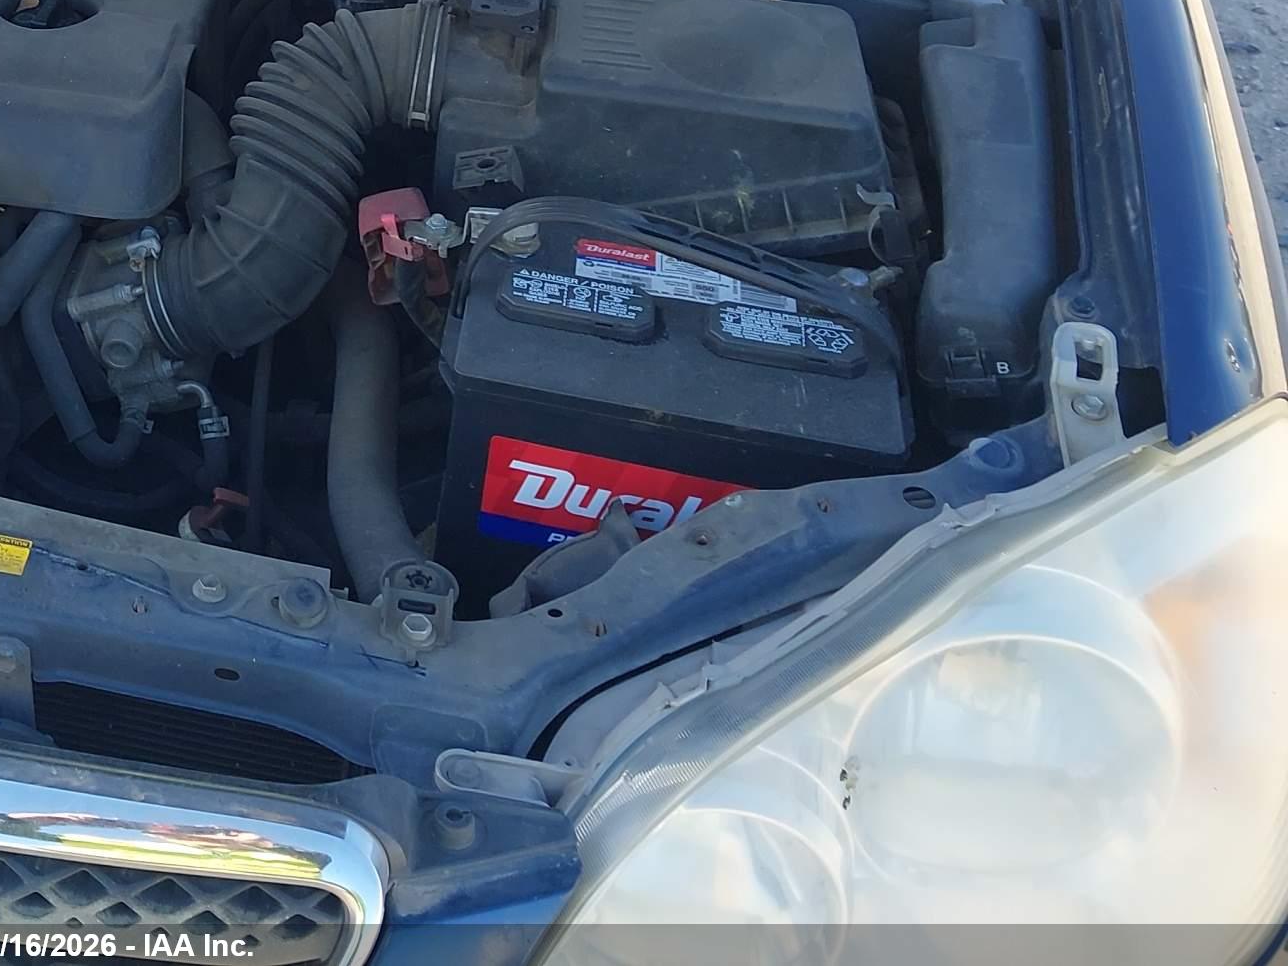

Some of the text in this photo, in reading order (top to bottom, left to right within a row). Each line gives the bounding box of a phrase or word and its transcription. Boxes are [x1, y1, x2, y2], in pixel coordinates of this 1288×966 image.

[583, 243, 650, 261] Duralast
[531, 270, 579, 286] DANGER
[590, 281, 634, 294] POISON
[996, 361, 1010, 374] B
